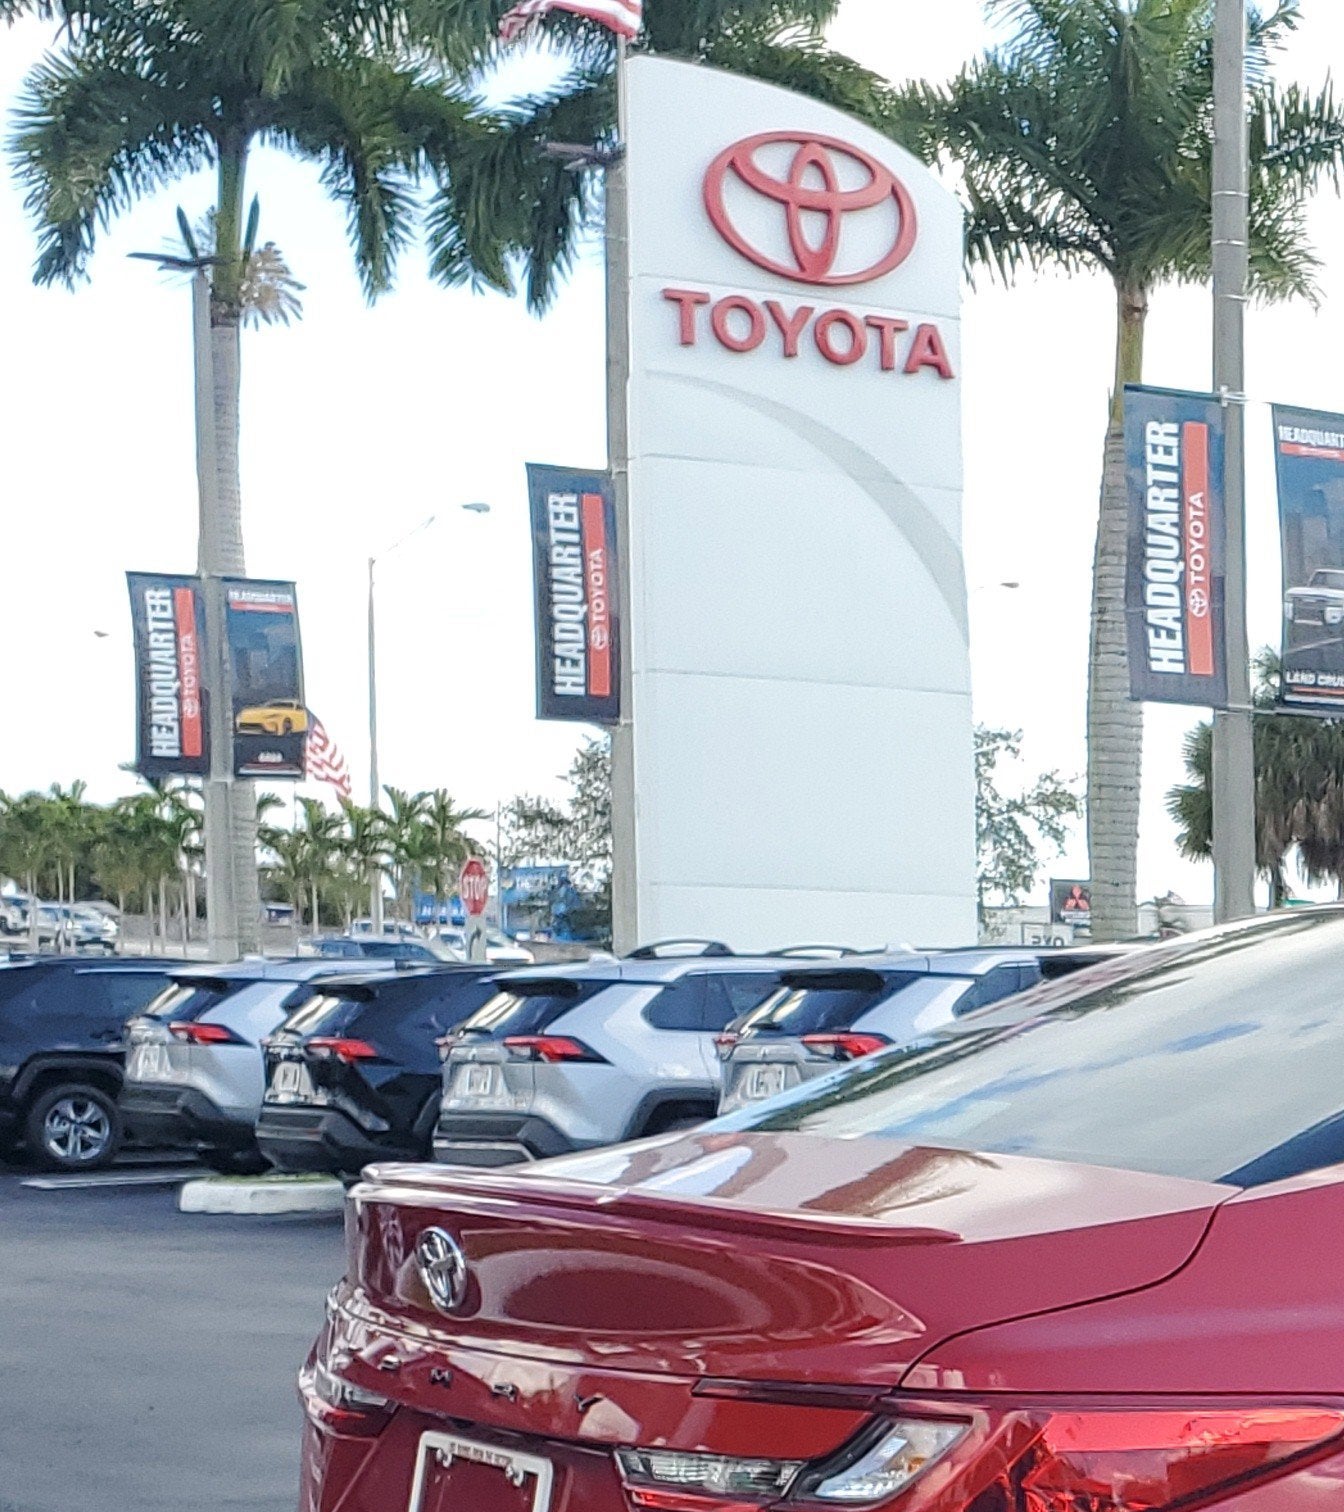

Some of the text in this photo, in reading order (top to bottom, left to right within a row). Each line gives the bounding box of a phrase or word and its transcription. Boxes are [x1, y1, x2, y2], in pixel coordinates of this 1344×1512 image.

[661, 288, 955, 380] TOYOTA
[589, 548, 606, 622] TOYOTA
[1144, 420, 1186, 674] HEADQUARTER
[1188, 492, 1206, 585] TOYOTA
[547, 492, 588, 696] HEADQUARTER
[145, 588, 181, 757] HEADQUARTER
[461, 874, 488, 900] STOP
